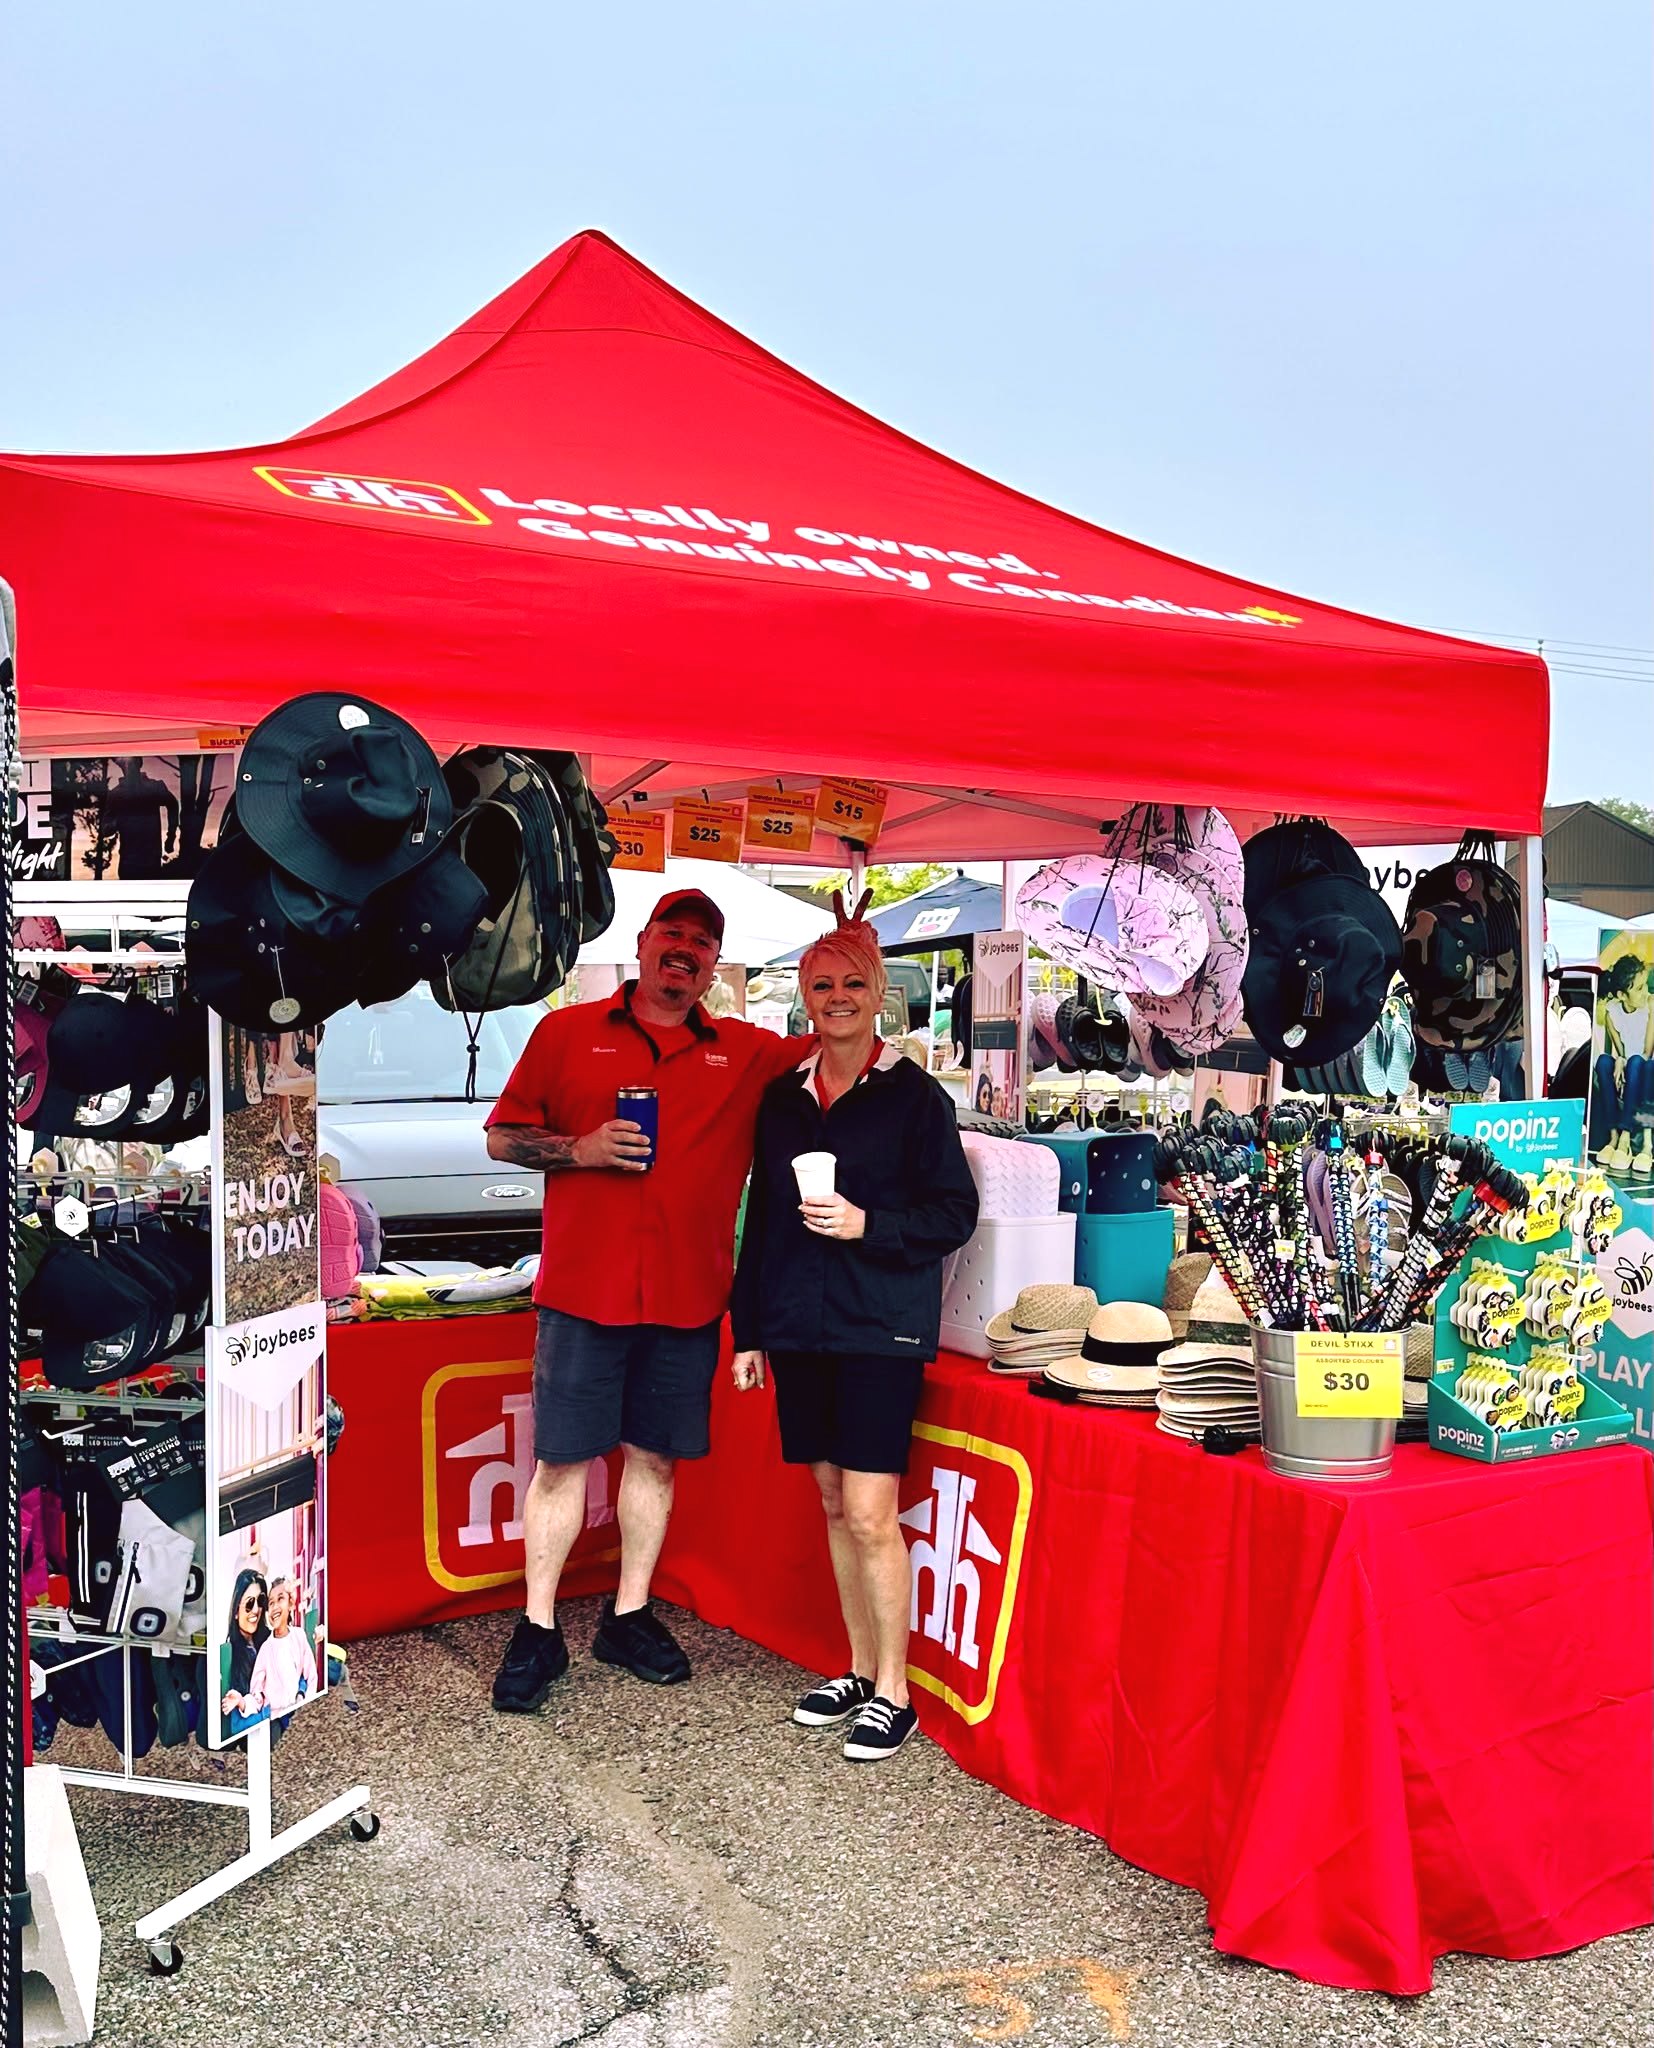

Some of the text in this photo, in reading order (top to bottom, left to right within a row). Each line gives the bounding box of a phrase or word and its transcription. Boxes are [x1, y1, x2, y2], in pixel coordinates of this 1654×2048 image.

[479, 487, 1060, 579] Locally owned.
[517, 518, 931, 590] Genuinely
[209, 738, 246, 746] BUCKET
[832, 799, 864, 820] $15
[689, 825, 721, 843] $25
[762, 818, 793, 834] $25
[989, 941, 1020, 956] joybees
[1475, 1109, 1561, 1150] popinz
[225, 1171, 305, 1218] ENJOY
[495, 1187, 523, 1197] Ford
[1529, 1218, 1555, 1231] popinz
[1595, 1212, 1618, 1225] popinz
[233, 1213, 315, 1262] TODAY
[1492, 1306, 1520, 1319] popinz
[1584, 1305, 1607, 1318] popinz
[1612, 1295, 1653, 1313] joybees
[252, 1325, 315, 1359] joybees
[1310, 1340, 1374, 1349] DEVIL STIXX
[1580, 1347, 1652, 1390] PLAY
[1323, 1371, 1370, 1391] $30
[1556, 1390, 1581, 1405] popinz
[1498, 1403, 1523, 1417] popinz
[1438, 1424, 1485, 1448] popinz
[140, 1451, 156, 1463] LED
[156, 1439, 181, 1455] SLING
